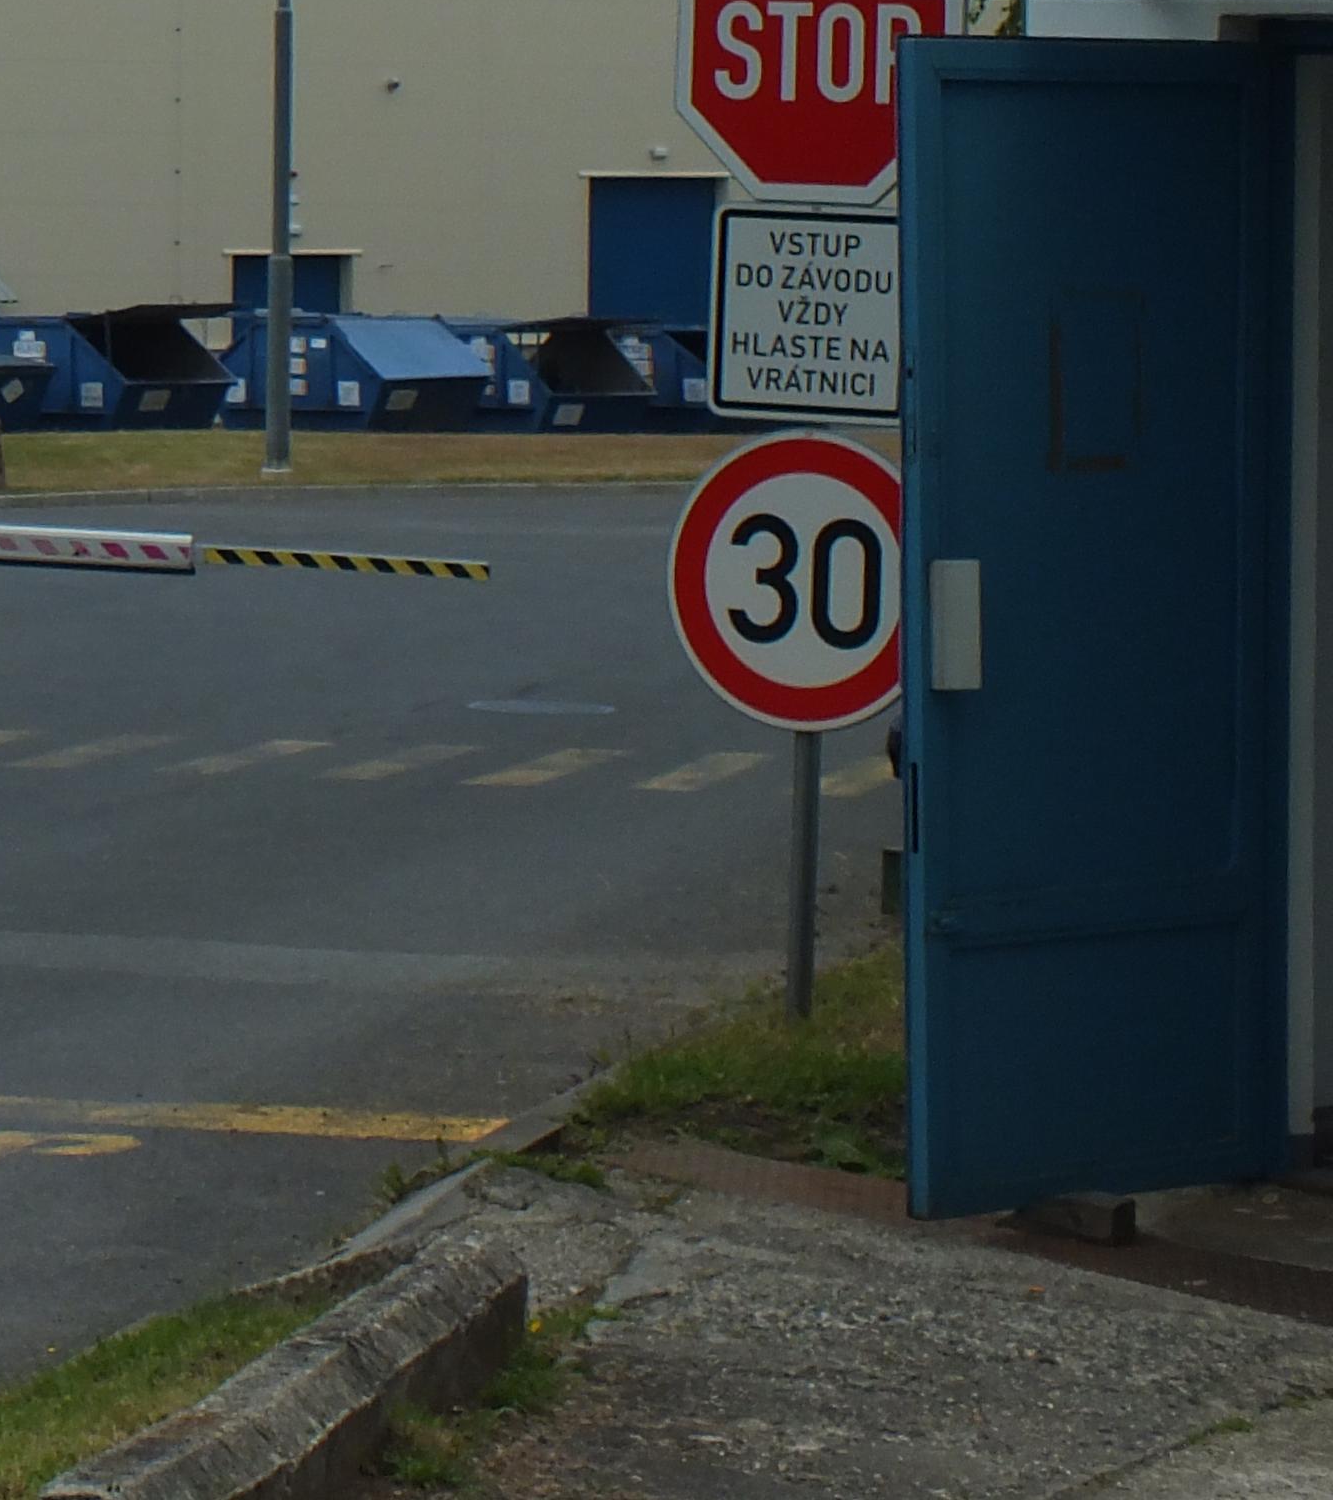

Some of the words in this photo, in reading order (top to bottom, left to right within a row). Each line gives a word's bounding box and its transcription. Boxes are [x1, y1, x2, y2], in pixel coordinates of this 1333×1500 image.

[769, 231, 862, 259] VSTUP
[736, 262, 773, 289] DO
[780, 260, 893, 296] ZÁVODU
[776, 297, 849, 328] VŽDY
[732, 332, 842, 362] HLASTE
[850, 338, 891, 364] NA
[746, 363, 876, 398] VRÁTNICI
[727, 512, 883, 651] 30
